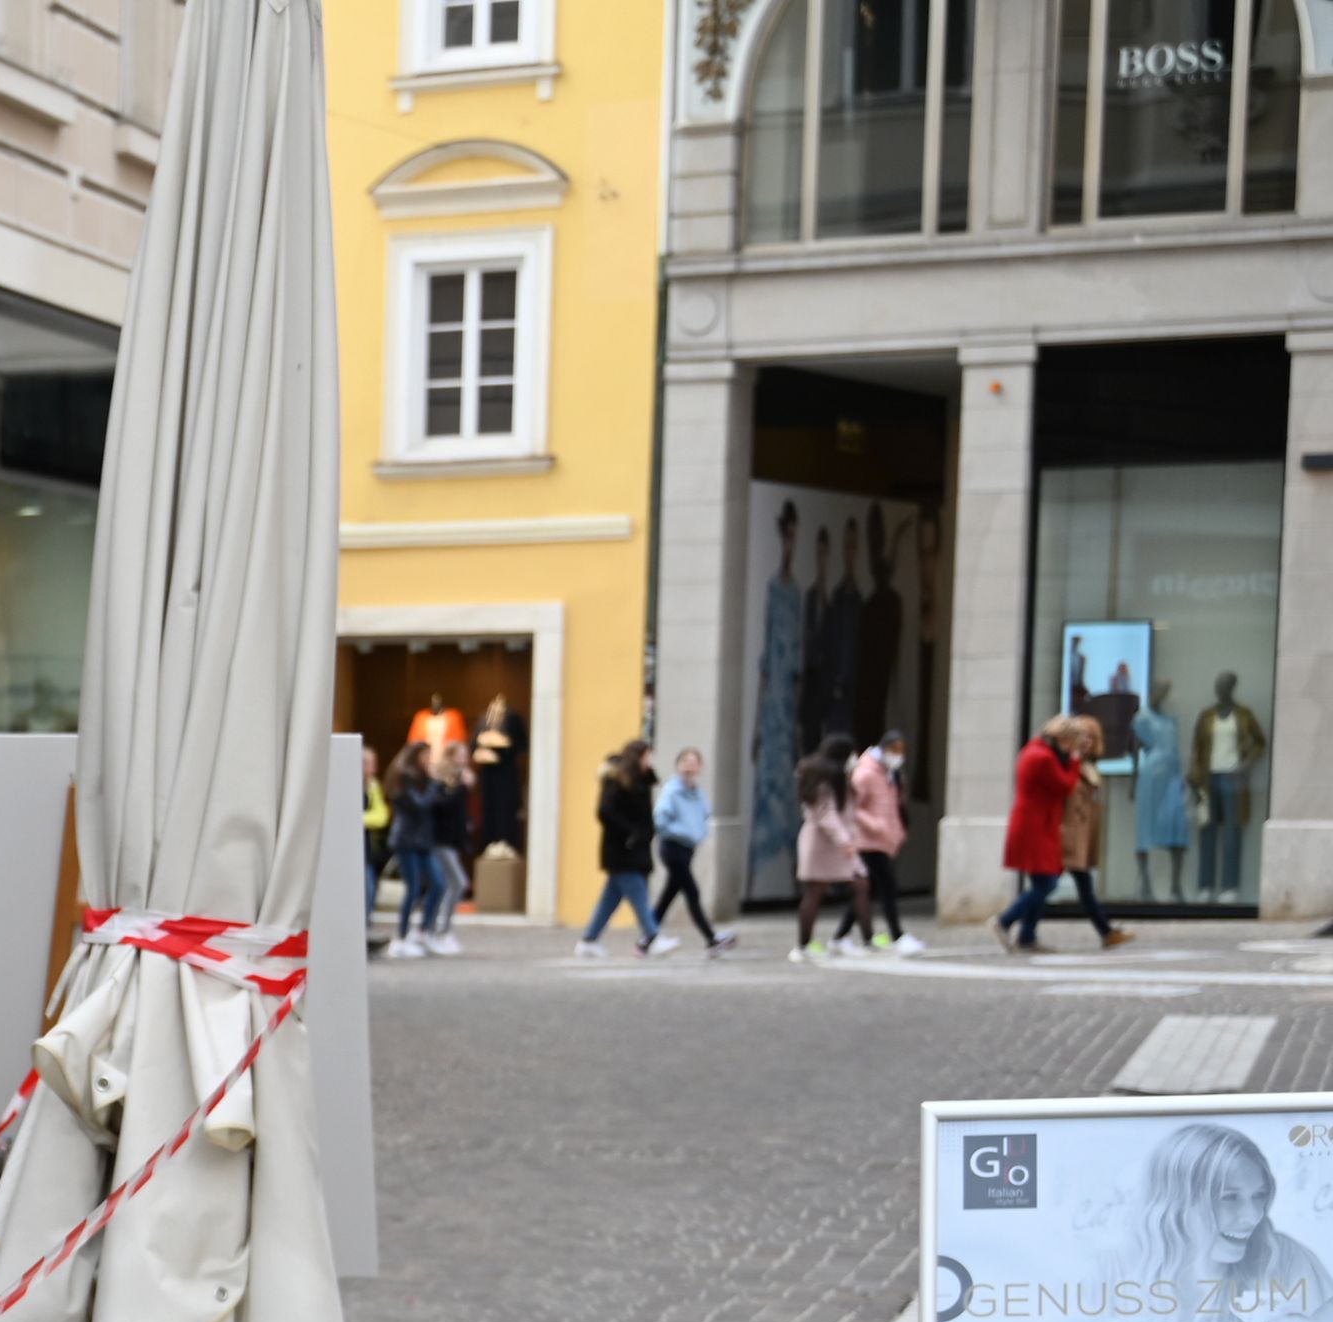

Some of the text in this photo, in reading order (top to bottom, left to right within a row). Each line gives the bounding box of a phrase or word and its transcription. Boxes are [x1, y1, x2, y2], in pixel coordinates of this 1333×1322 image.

[1118, 40, 1224, 78] BOSS
[988, 1188, 1023, 1197] Italian
[964, 1278, 1308, 1317] GENUSS ZUM
